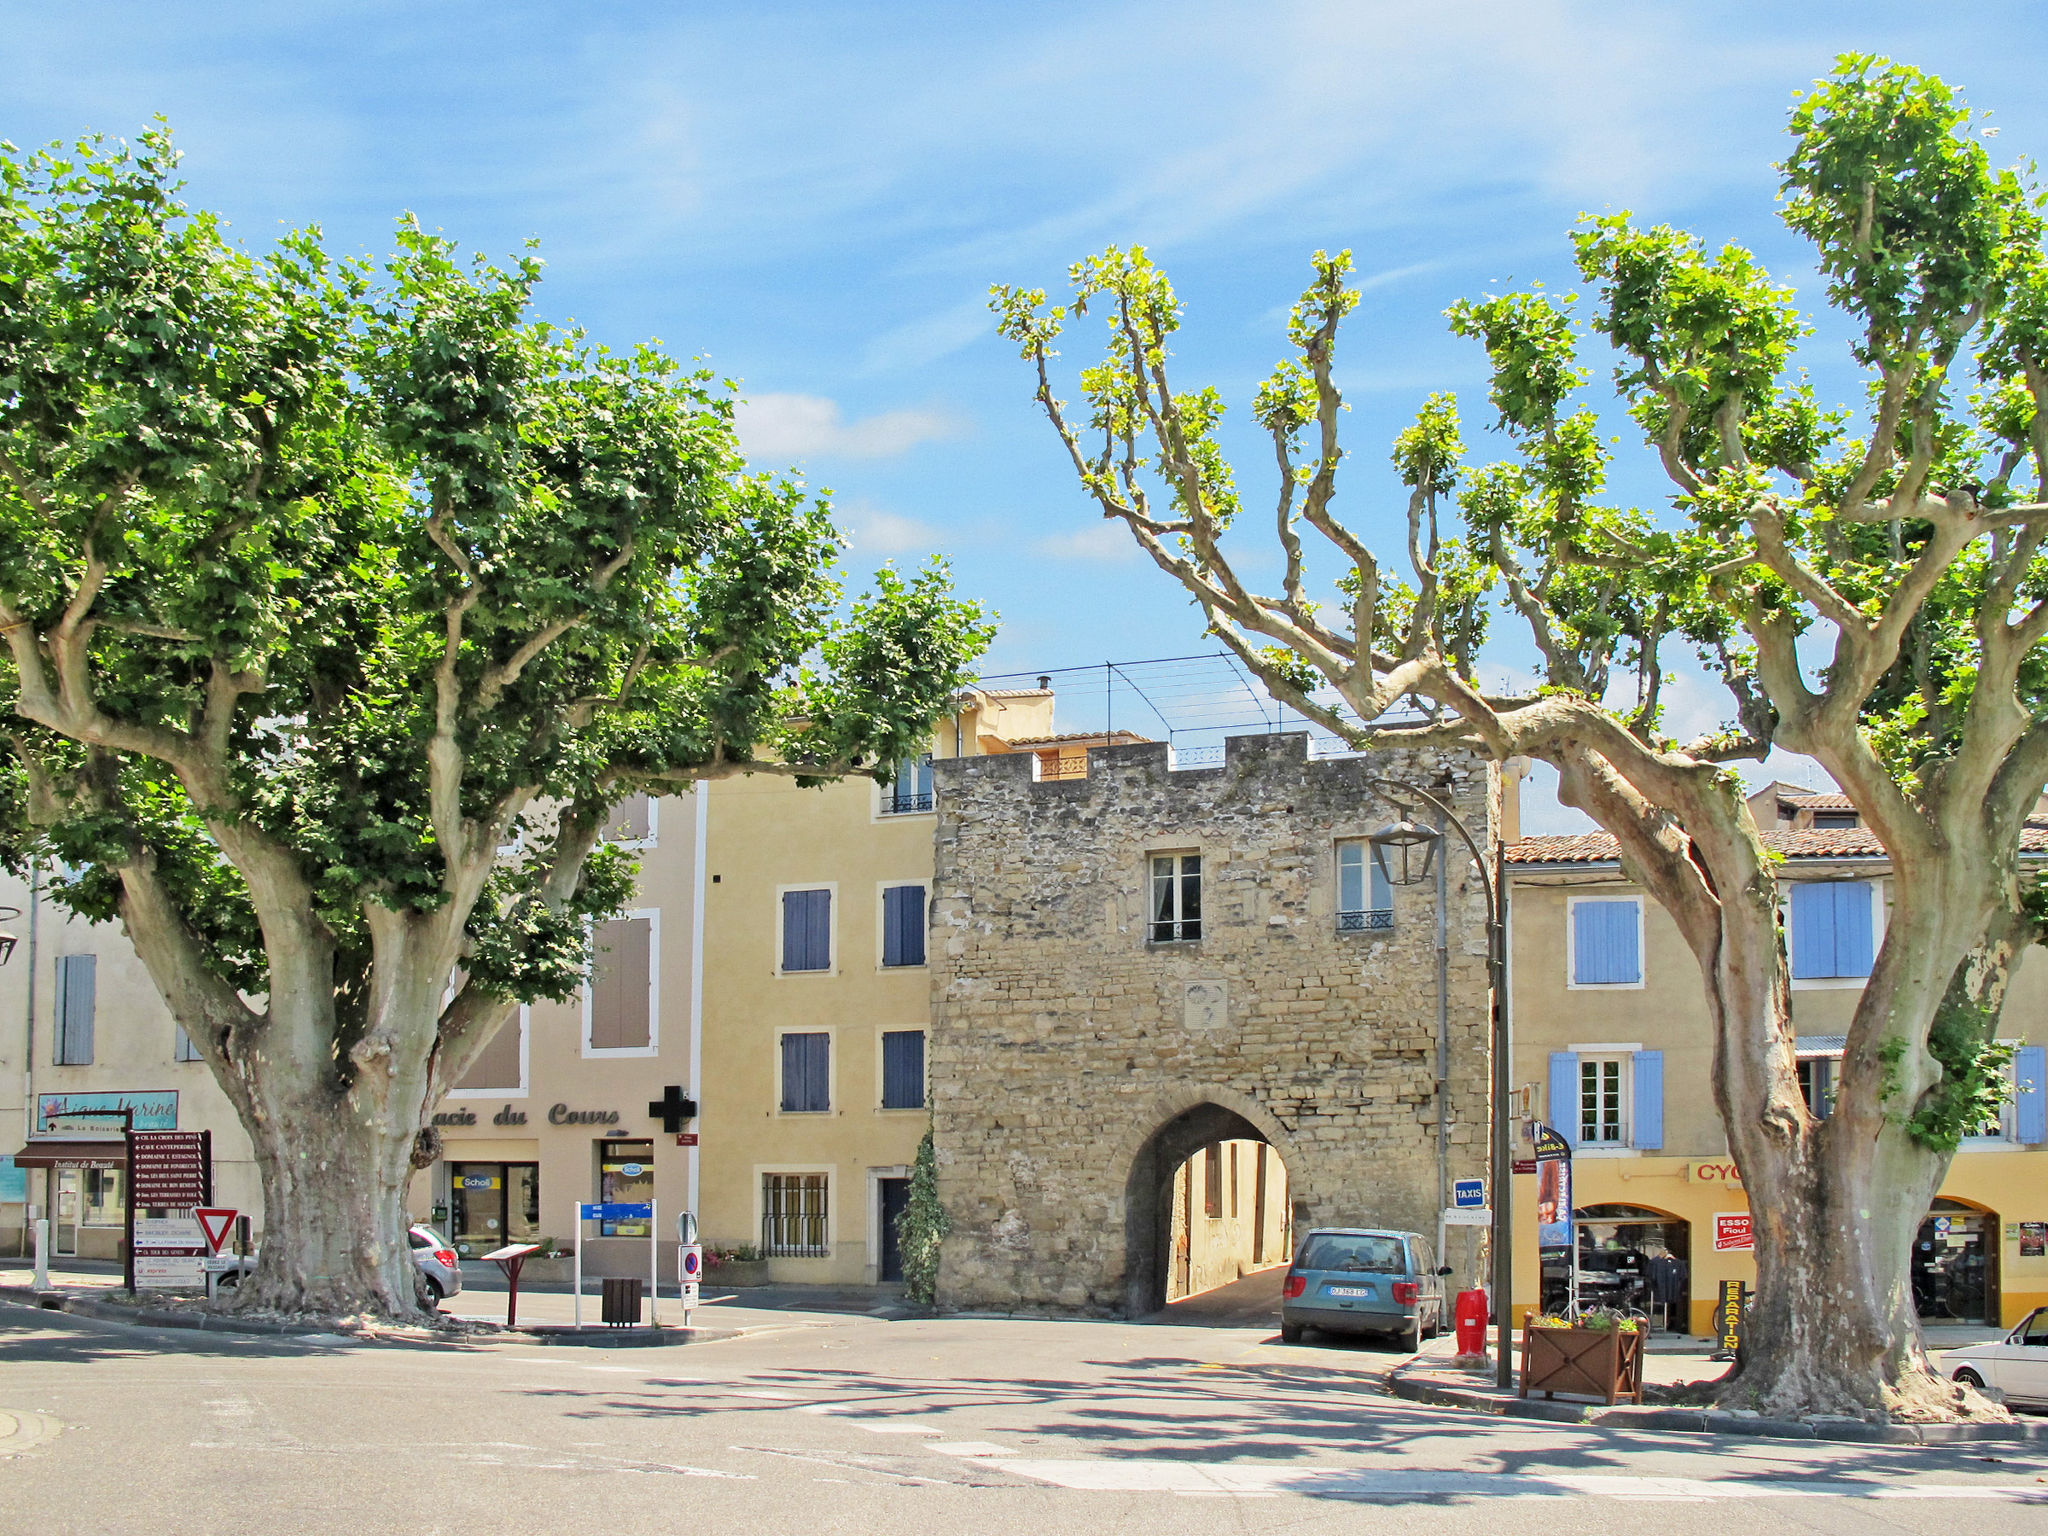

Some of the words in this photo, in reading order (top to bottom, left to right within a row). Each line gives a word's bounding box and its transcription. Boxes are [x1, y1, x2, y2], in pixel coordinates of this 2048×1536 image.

[493, 1104, 528, 1126] du
[548, 1103, 620, 1126] Cours
[54, 1160, 79, 1168] Institut
[90, 1161, 114, 1169] Beauté
[464, 1178, 490, 1187] Scholl
[1457, 1189, 1481, 1198] TAXIS
[1724, 1281, 1740, 1349] REPARATION
